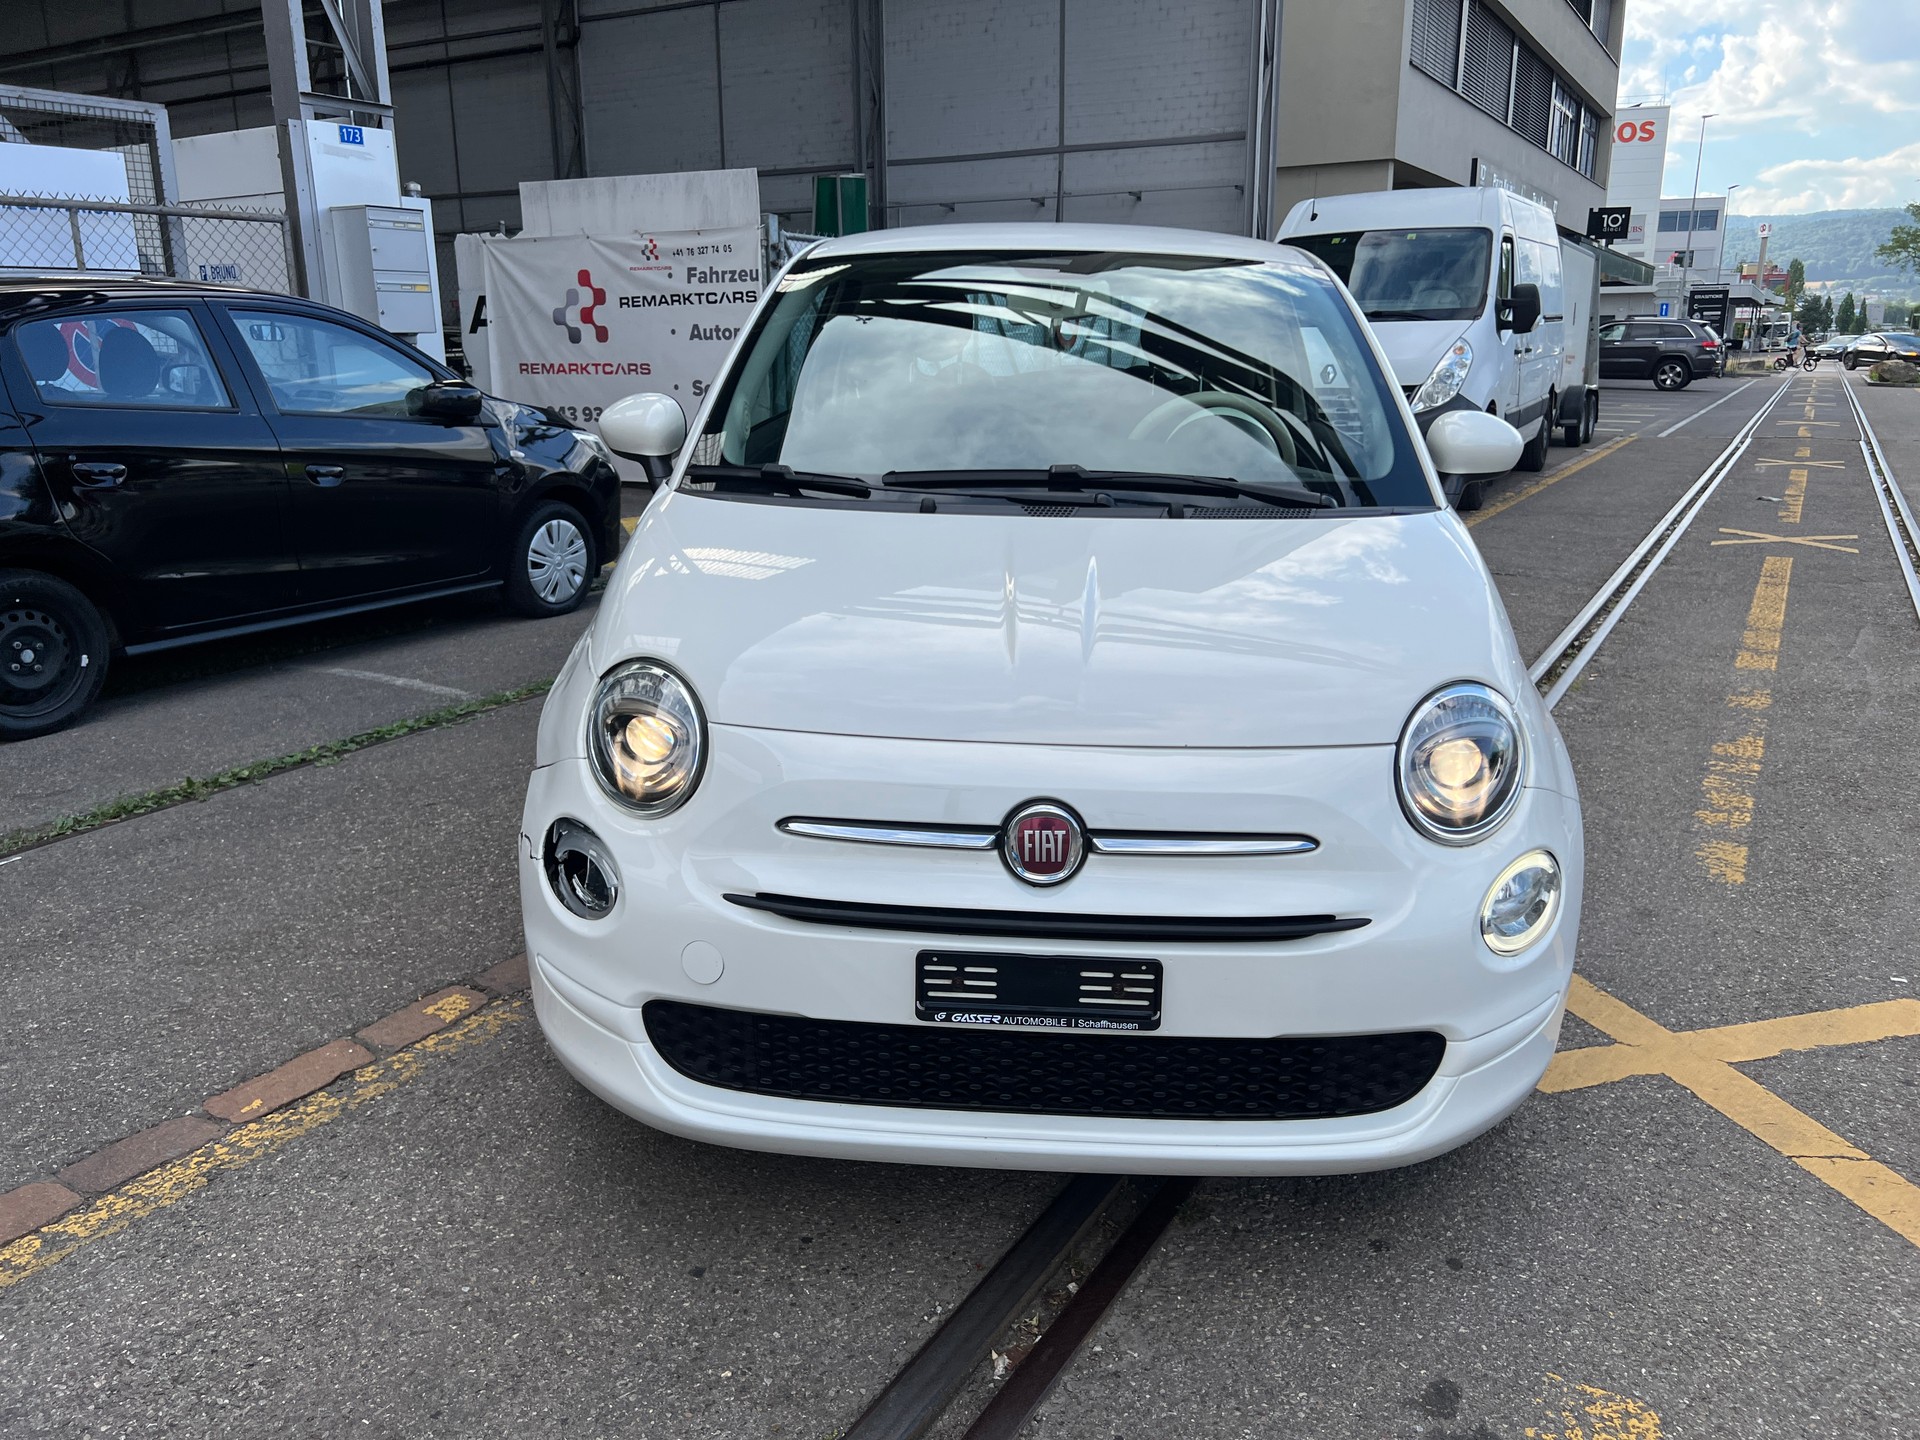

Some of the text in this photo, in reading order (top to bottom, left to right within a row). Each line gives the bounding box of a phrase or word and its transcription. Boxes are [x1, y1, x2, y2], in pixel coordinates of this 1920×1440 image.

[342, 127, 361, 143] 173
[1612, 120, 1656, 144] OS
[672, 244, 732, 257] +41 76 327 74 05
[211, 265, 237, 280] BRUNO
[686, 266, 759, 284] Fahrzeu
[619, 290, 758, 309] REMARKTCARS
[519, 362, 652, 376] REMARKTCARS
[1023, 829, 1066, 863] FIAT
[951, 1013, 1002, 1024] GASSER
[1003, 1016, 1068, 1027] AUTOMOBILE
[1077, 1019, 1139, 1030] Schaffhausen
